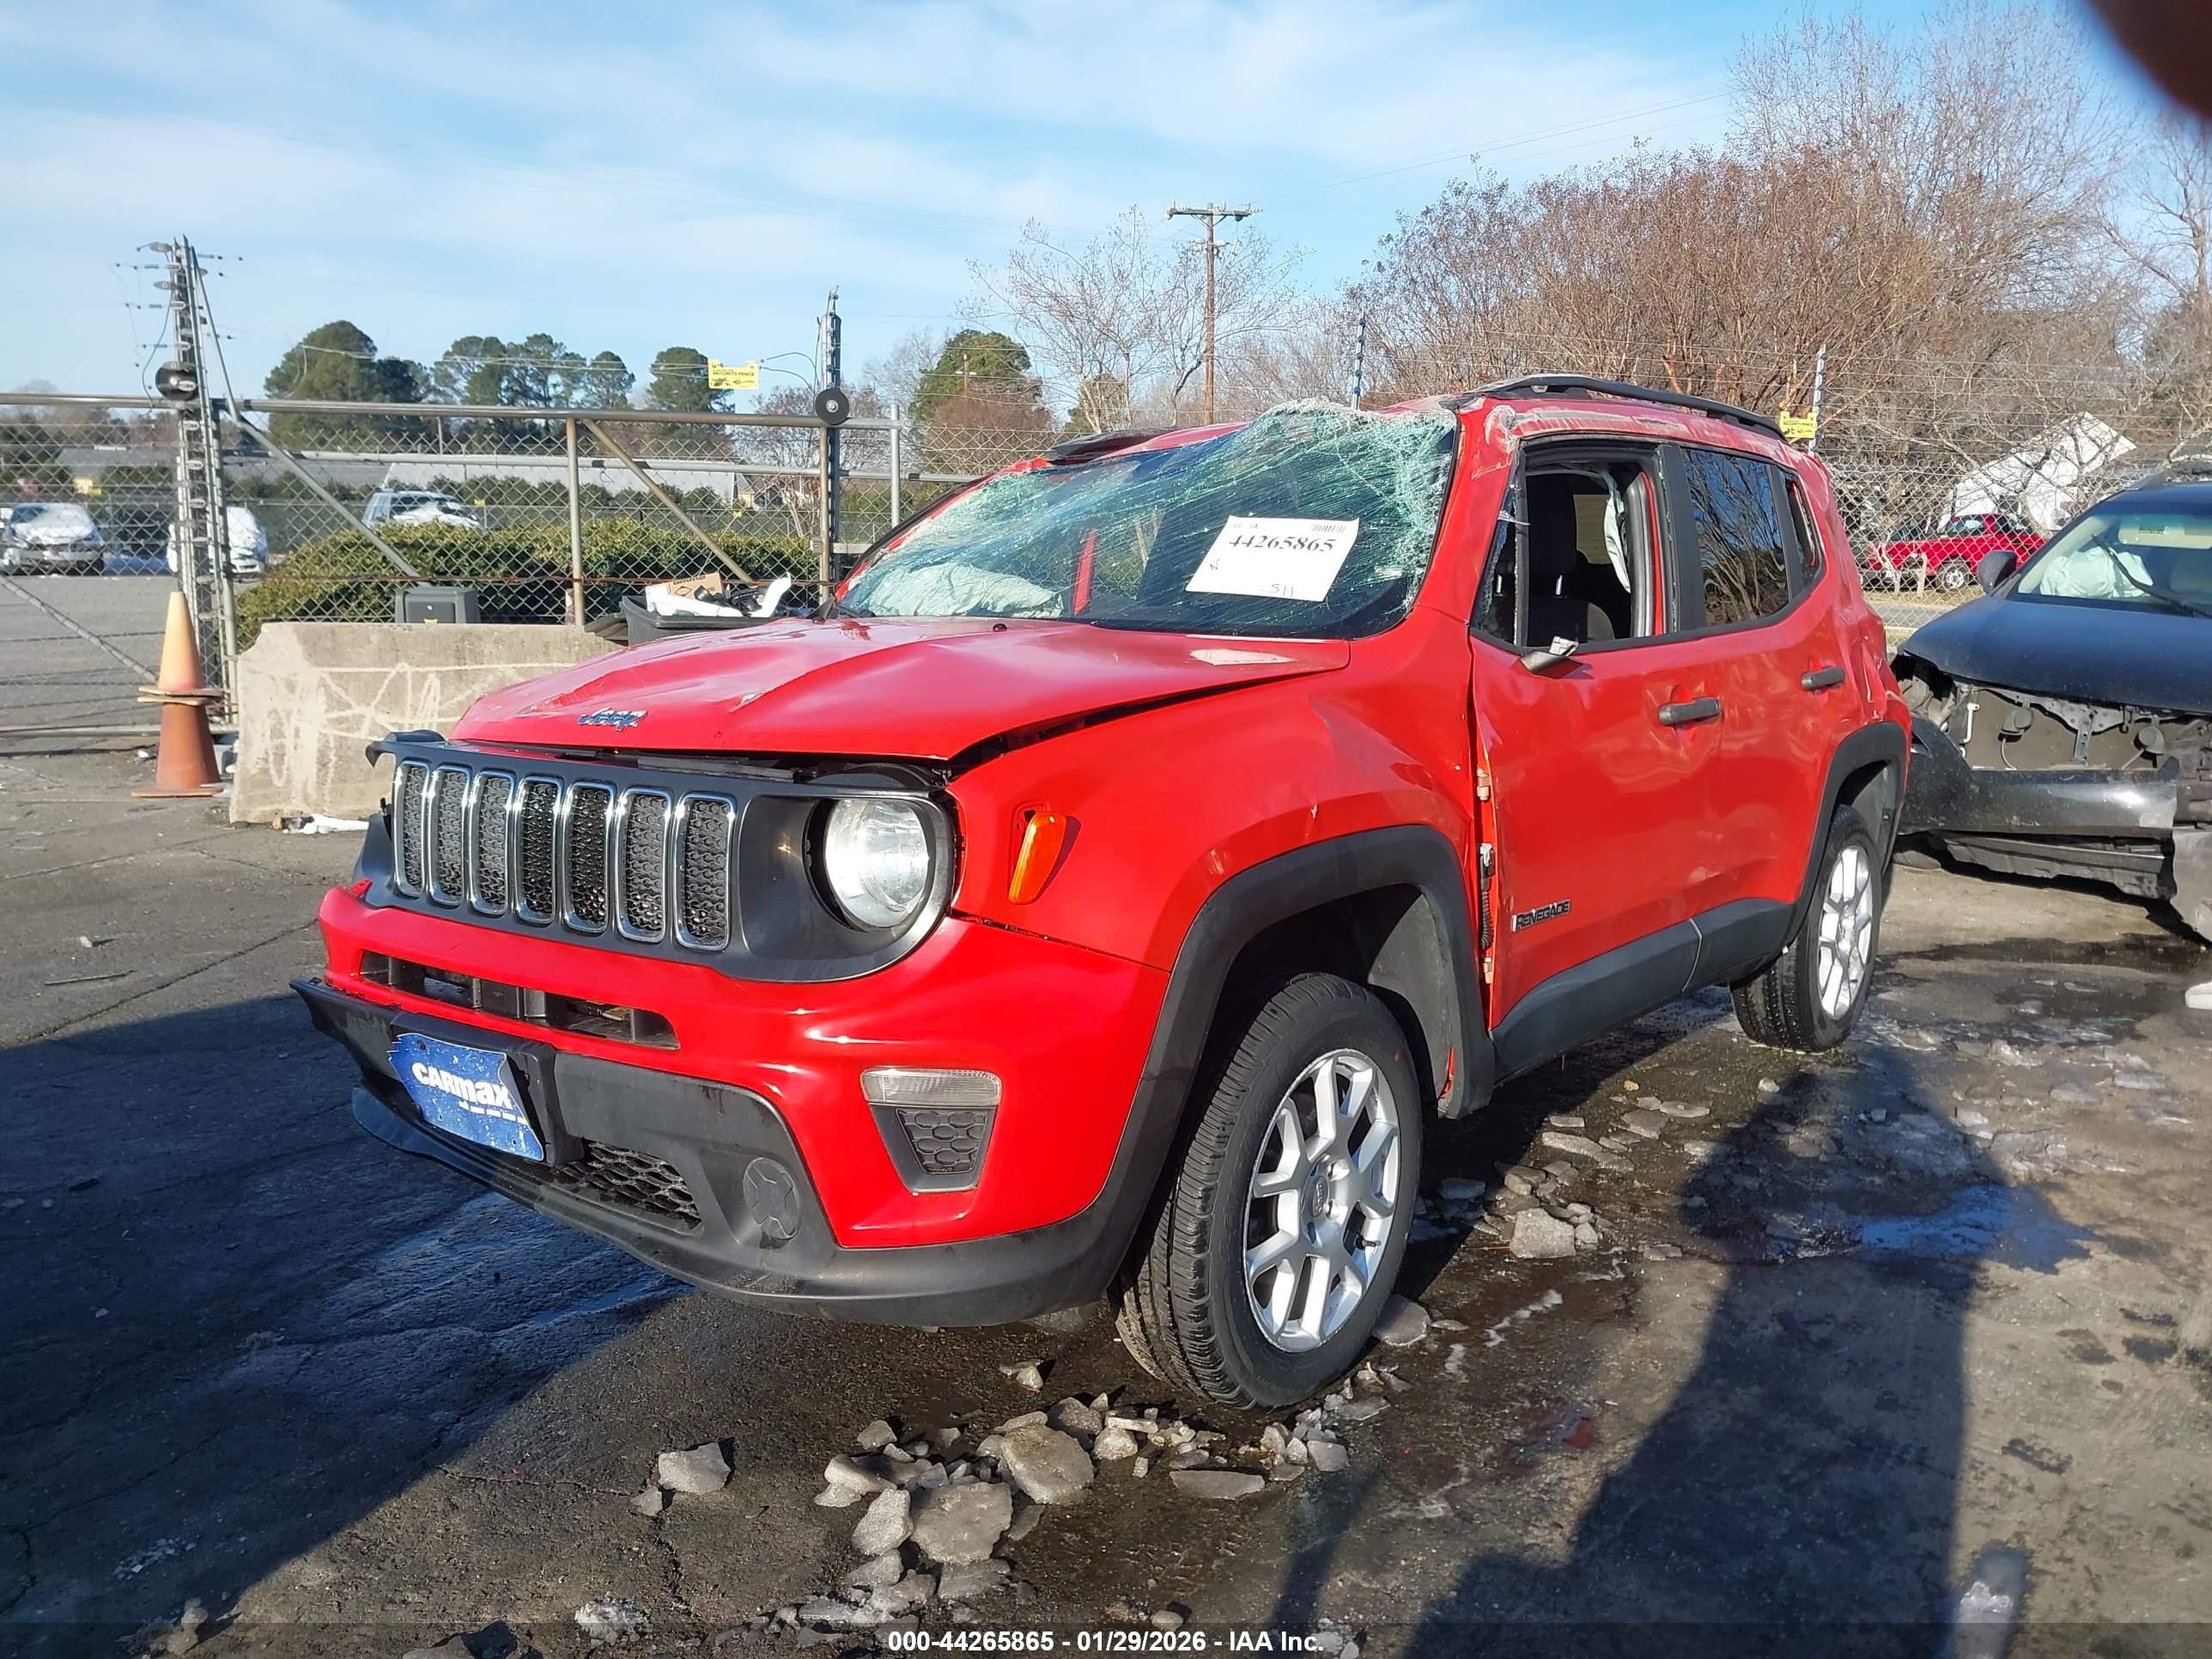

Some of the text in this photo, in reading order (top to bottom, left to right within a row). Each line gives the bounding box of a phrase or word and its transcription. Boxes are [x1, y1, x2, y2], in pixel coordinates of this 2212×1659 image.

[1229, 534, 1337, 552] 44265865
[577, 708, 647, 732] Jeep
[1512, 899, 1571, 932] RENEGADE
